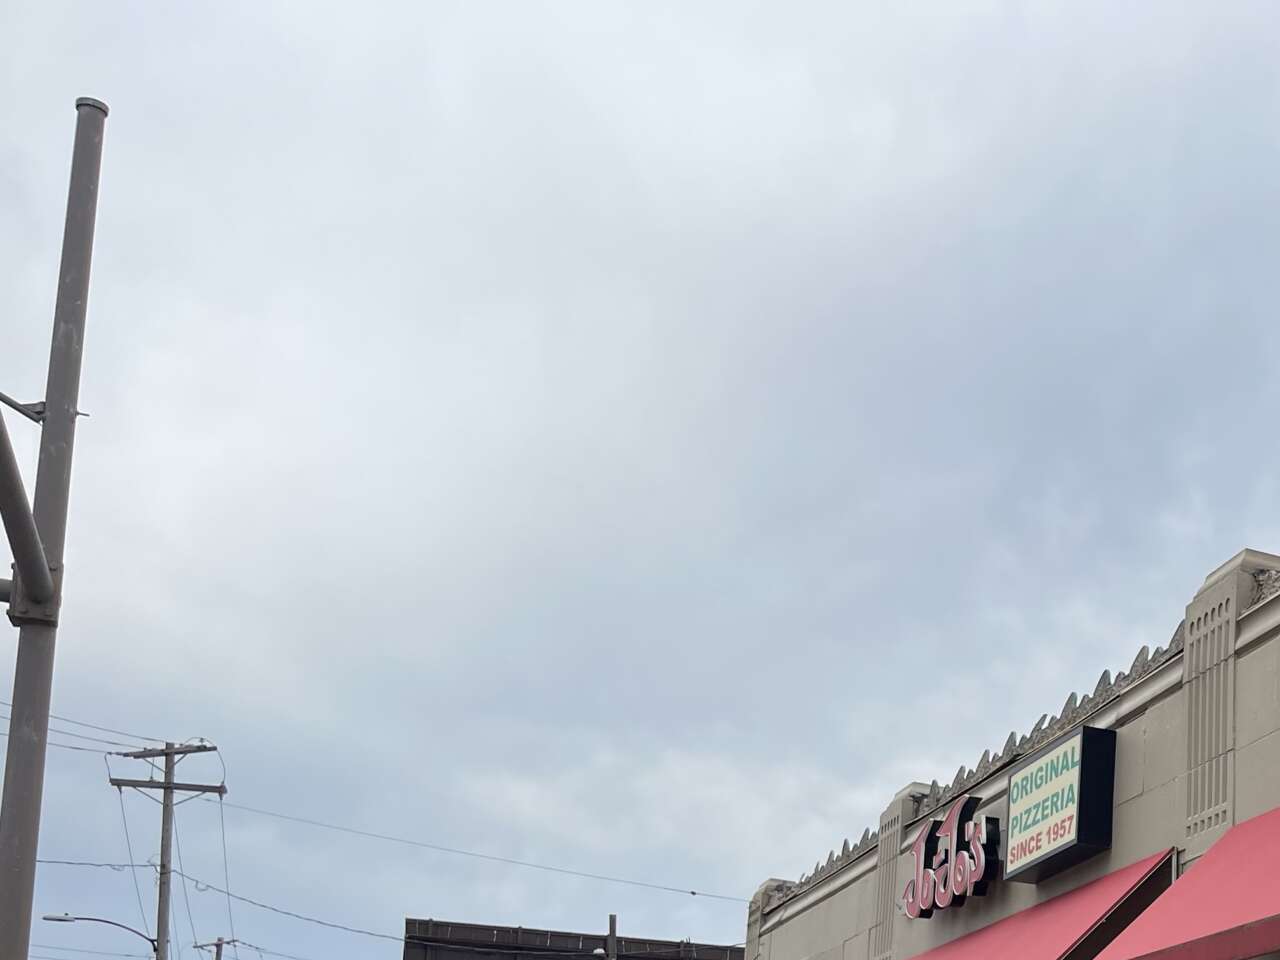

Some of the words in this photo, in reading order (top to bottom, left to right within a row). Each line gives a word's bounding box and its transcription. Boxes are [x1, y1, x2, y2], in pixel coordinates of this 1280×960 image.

[1010, 745, 1080, 805] ORIGINAL
[1010, 783, 1076, 839] PIZZERIA
[1008, 829, 1043, 866] SINCE
[1045, 814, 1075, 844] 1957
